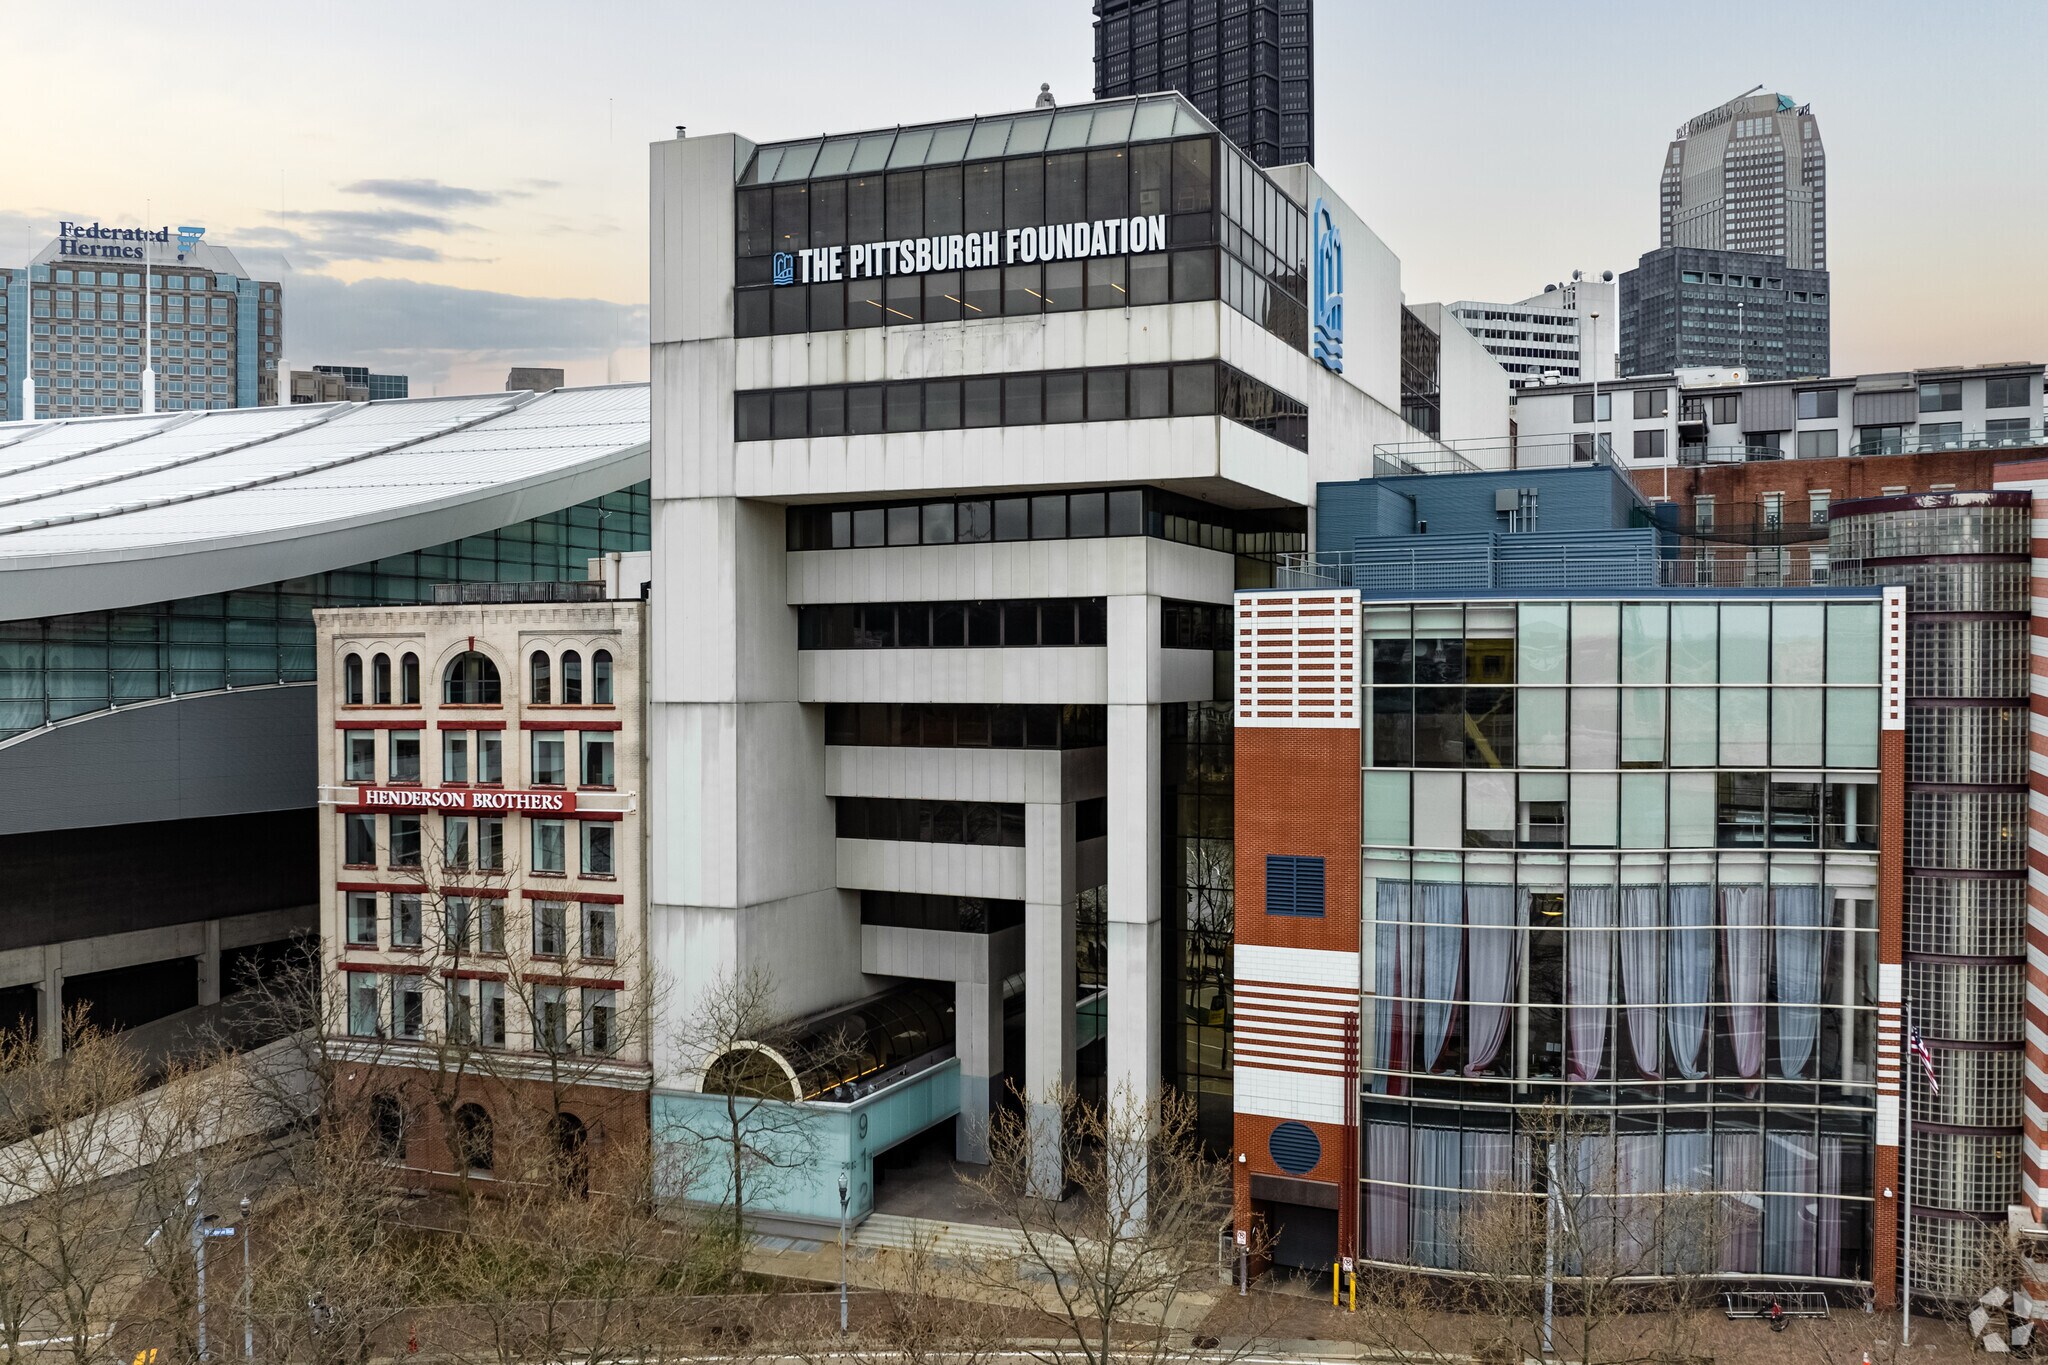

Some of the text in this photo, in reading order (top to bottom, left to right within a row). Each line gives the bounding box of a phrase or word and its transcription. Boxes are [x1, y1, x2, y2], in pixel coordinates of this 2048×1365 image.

[59, 221, 169, 243] Federated
[59, 239, 143, 259] Hermes
[799, 214, 1166, 284] THE PITTSBURGH FOUNDATION
[365, 790, 564, 811] HENDERSON BROTHERS
